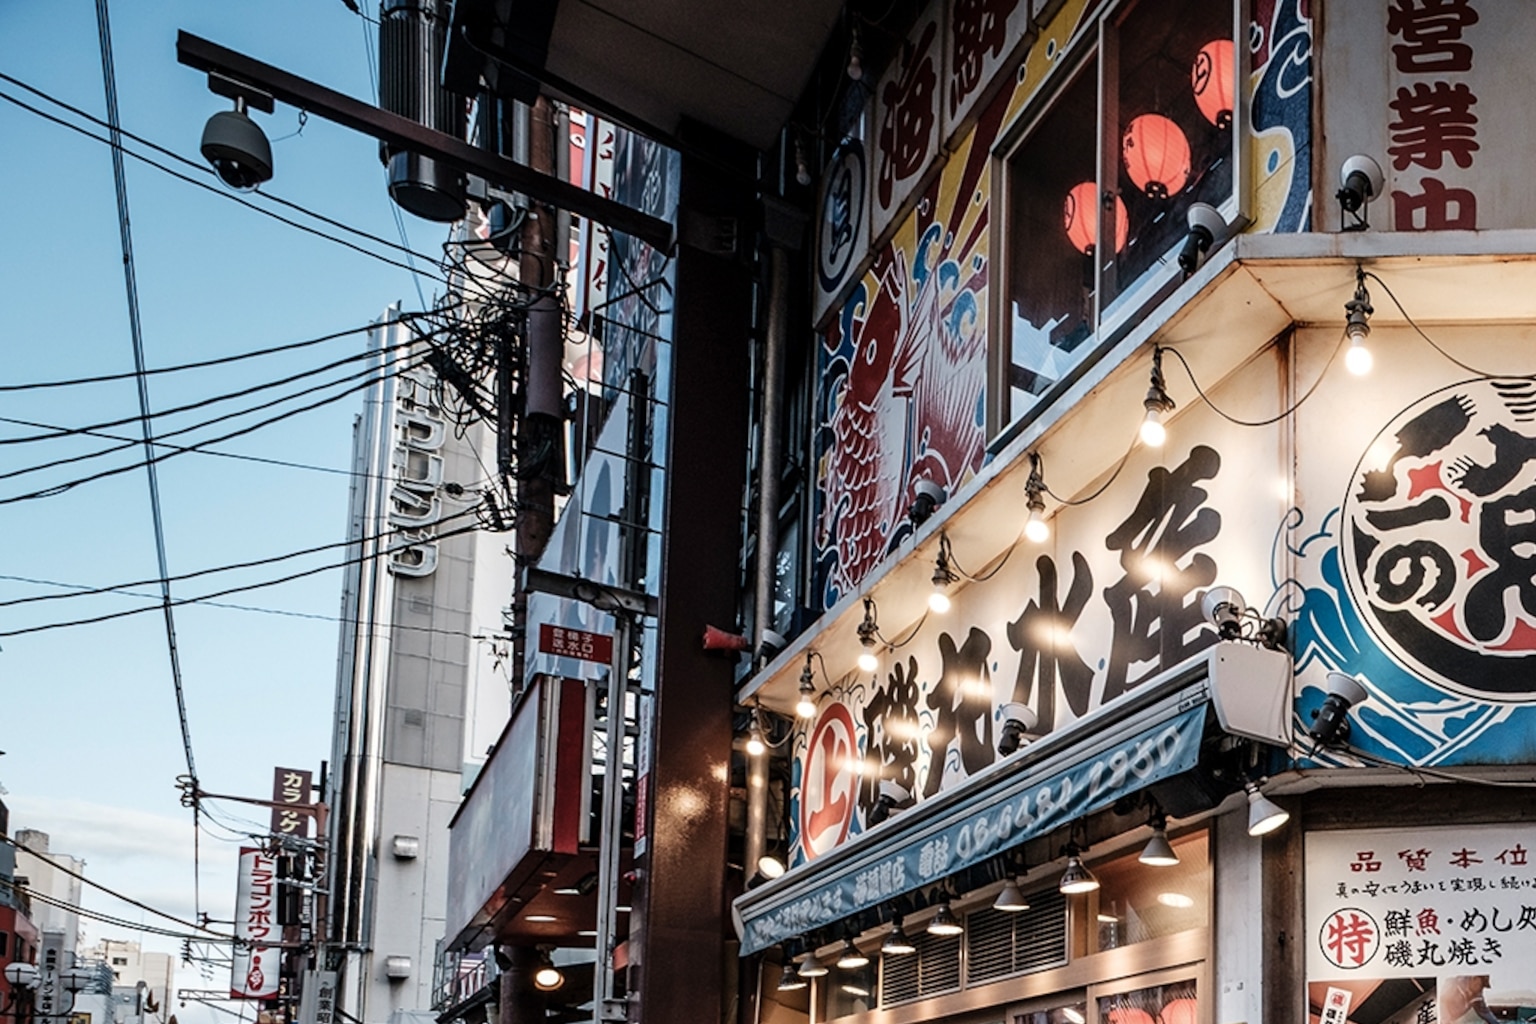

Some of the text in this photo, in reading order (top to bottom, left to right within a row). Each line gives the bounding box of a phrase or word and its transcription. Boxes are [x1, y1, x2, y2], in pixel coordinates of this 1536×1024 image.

[1387, 0, 1480, 231] 営業中
[857, 444, 1223, 824] 磯丸水産
[1350, 844, 1528, 873] 品質本位
[1323, 910, 1377, 967] 特
[1383, 937, 1504, 968] 磯丸焼き
